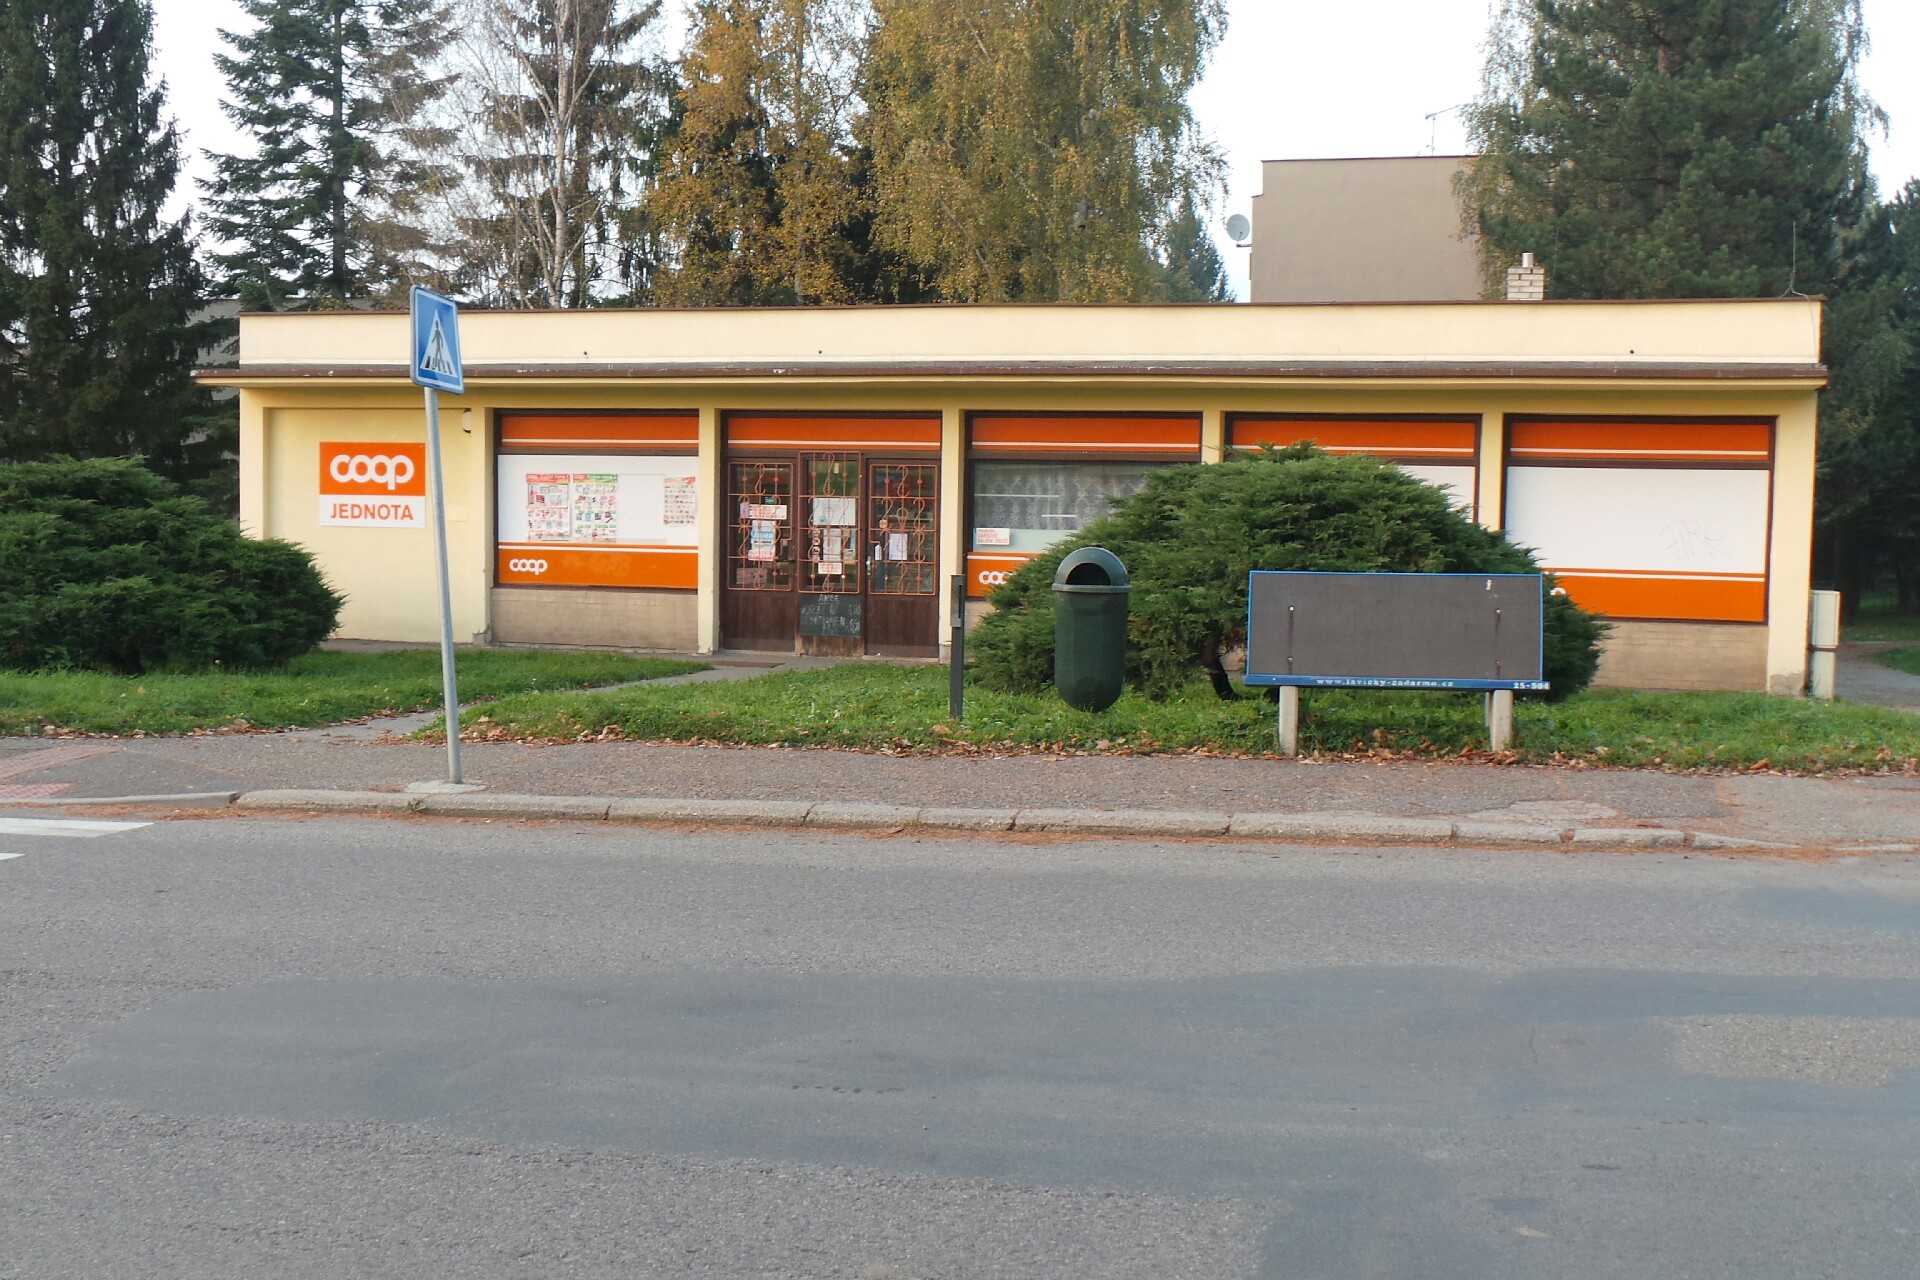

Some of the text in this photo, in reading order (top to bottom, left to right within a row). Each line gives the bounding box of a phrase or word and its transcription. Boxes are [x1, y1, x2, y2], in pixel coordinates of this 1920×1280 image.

[329, 454, 415, 491] coop
[330, 503, 414, 520] JEDNOTA
[508, 558, 548, 575] coop
